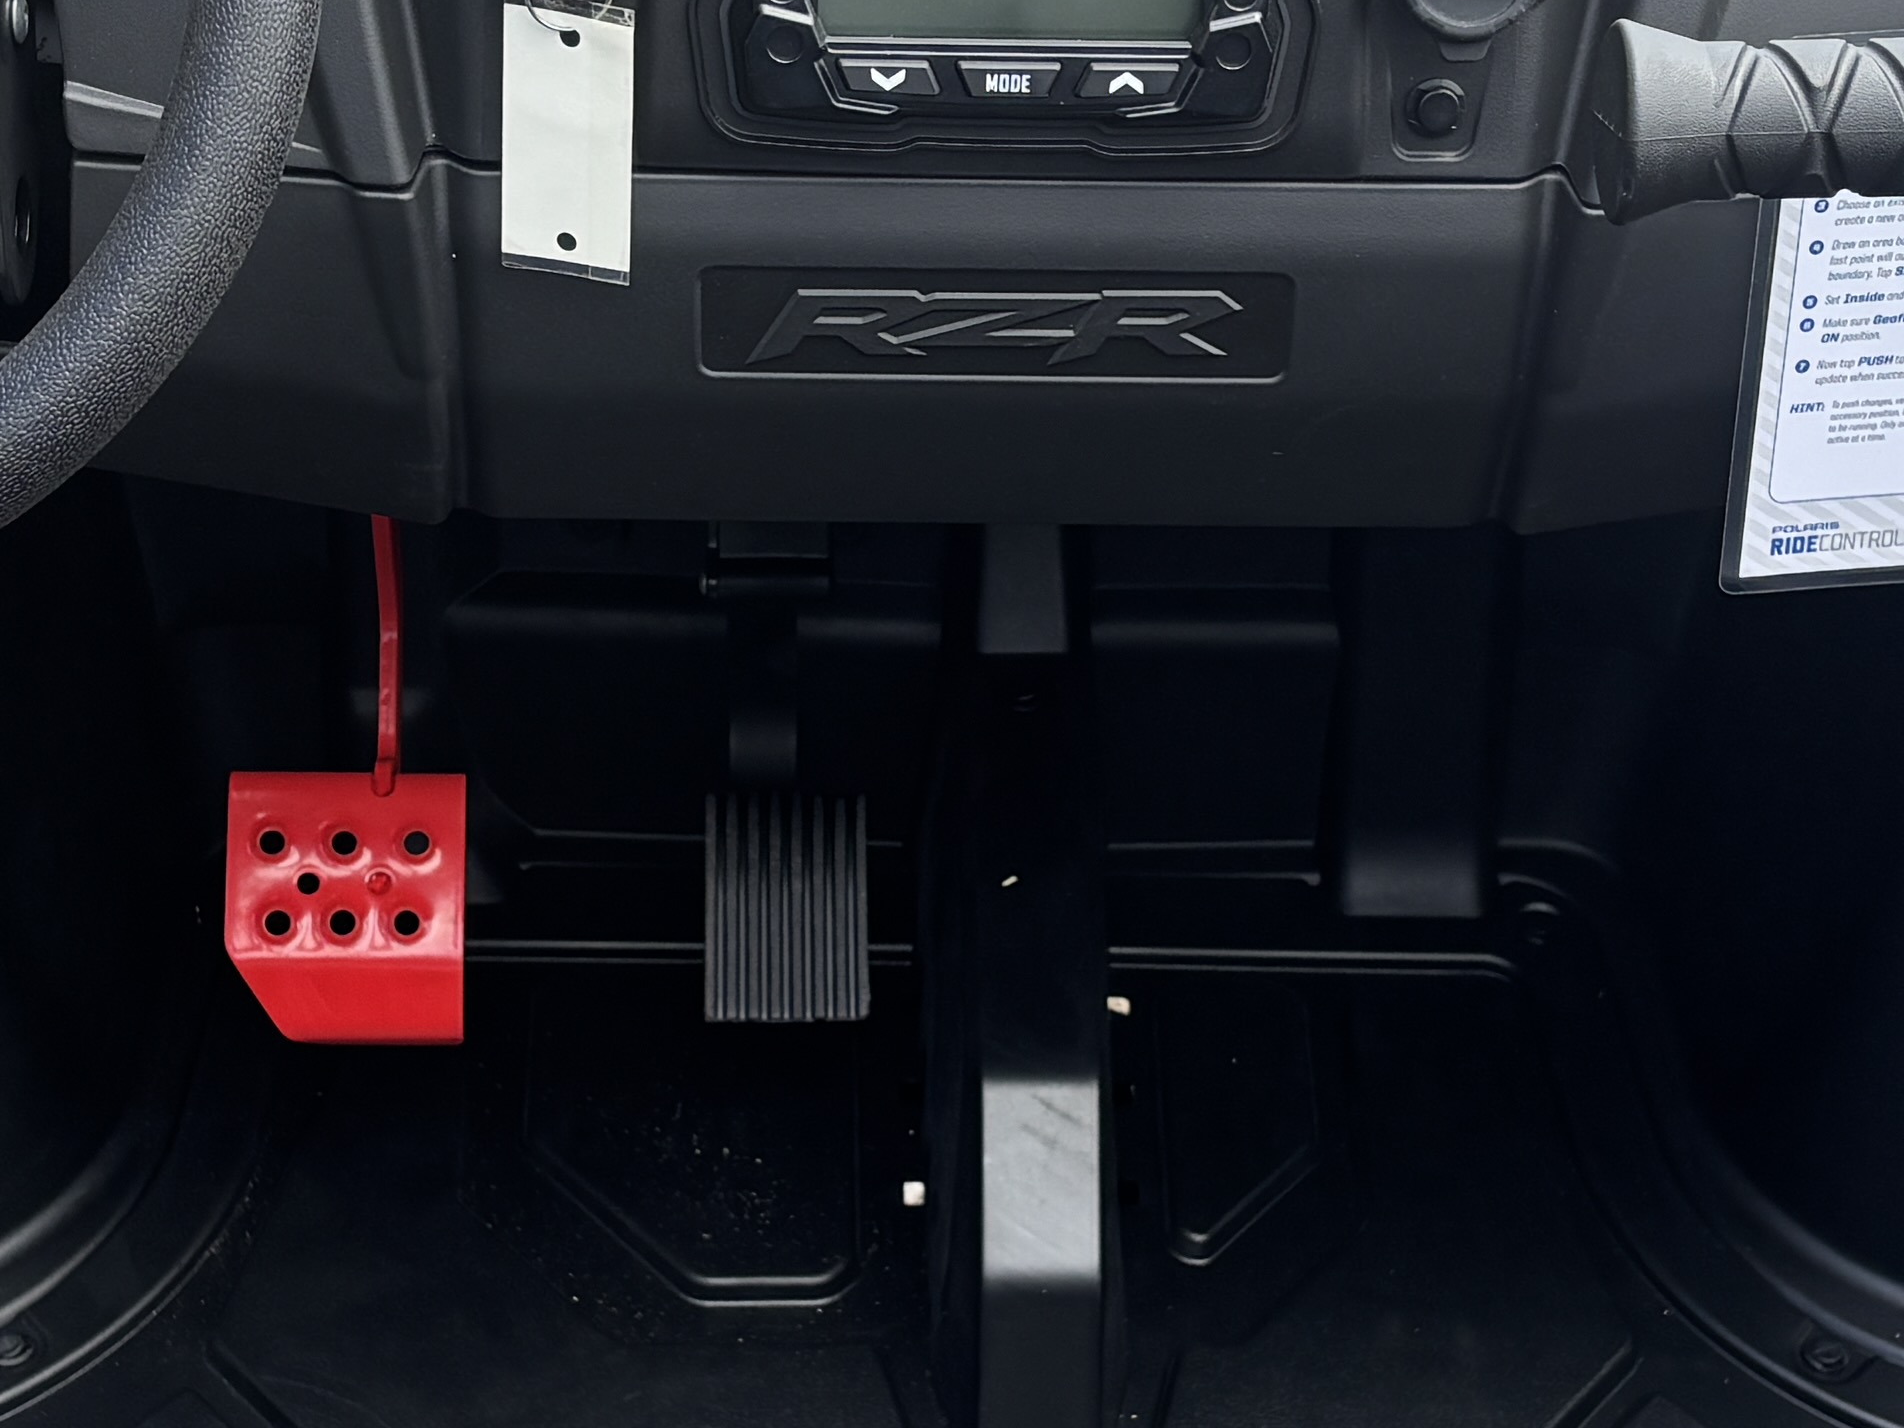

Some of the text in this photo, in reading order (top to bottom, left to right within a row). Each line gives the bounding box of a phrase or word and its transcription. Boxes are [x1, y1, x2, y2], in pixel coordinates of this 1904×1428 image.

[985, 73, 1031, 93] MODE
[1843, 292, 1885, 304] Inside
[745, 289, 1244, 366] RZR
[1821, 332, 1840, 343] ON
[1857, 355, 1894, 366] PUSH
[1772, 522, 1840, 534] POLARIS
